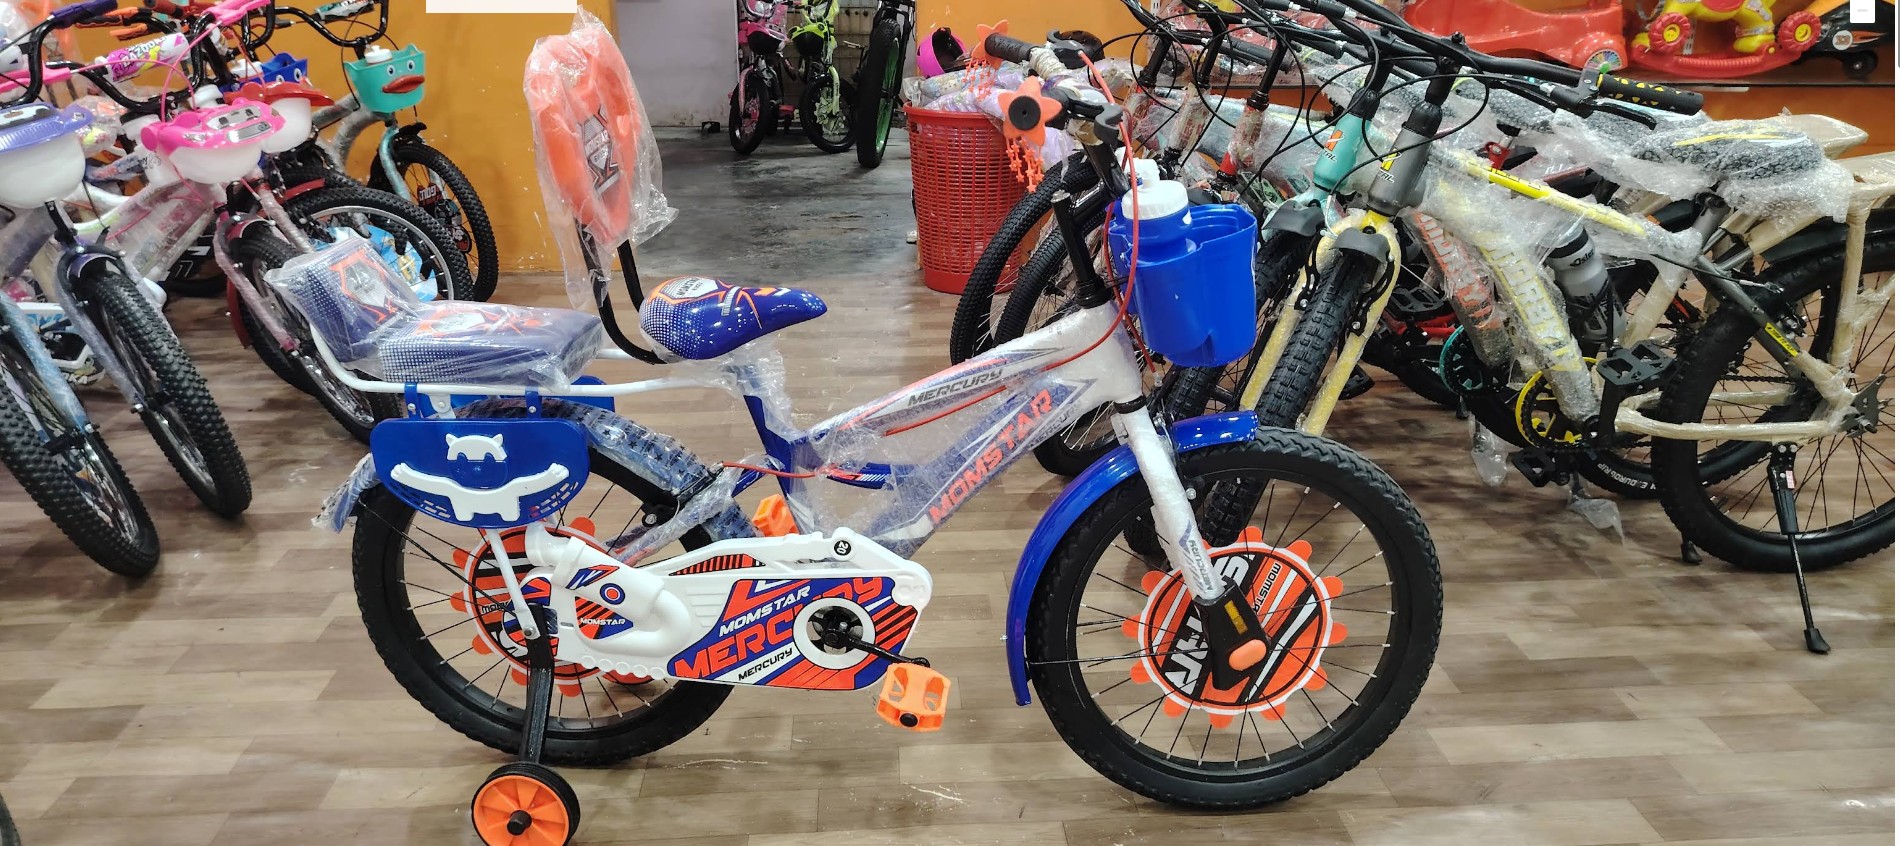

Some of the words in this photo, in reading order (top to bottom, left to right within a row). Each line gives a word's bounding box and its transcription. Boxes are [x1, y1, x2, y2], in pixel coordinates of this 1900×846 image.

[907, 368, 1004, 406] MERCURY
[929, 389, 1053, 524] MOMSTAR
[836, 541, 849, 555] 20
[580, 617, 626, 625] MOMSTAR
[719, 586, 811, 637] MOMSTAR
[738, 648, 793, 681] MERCURY
